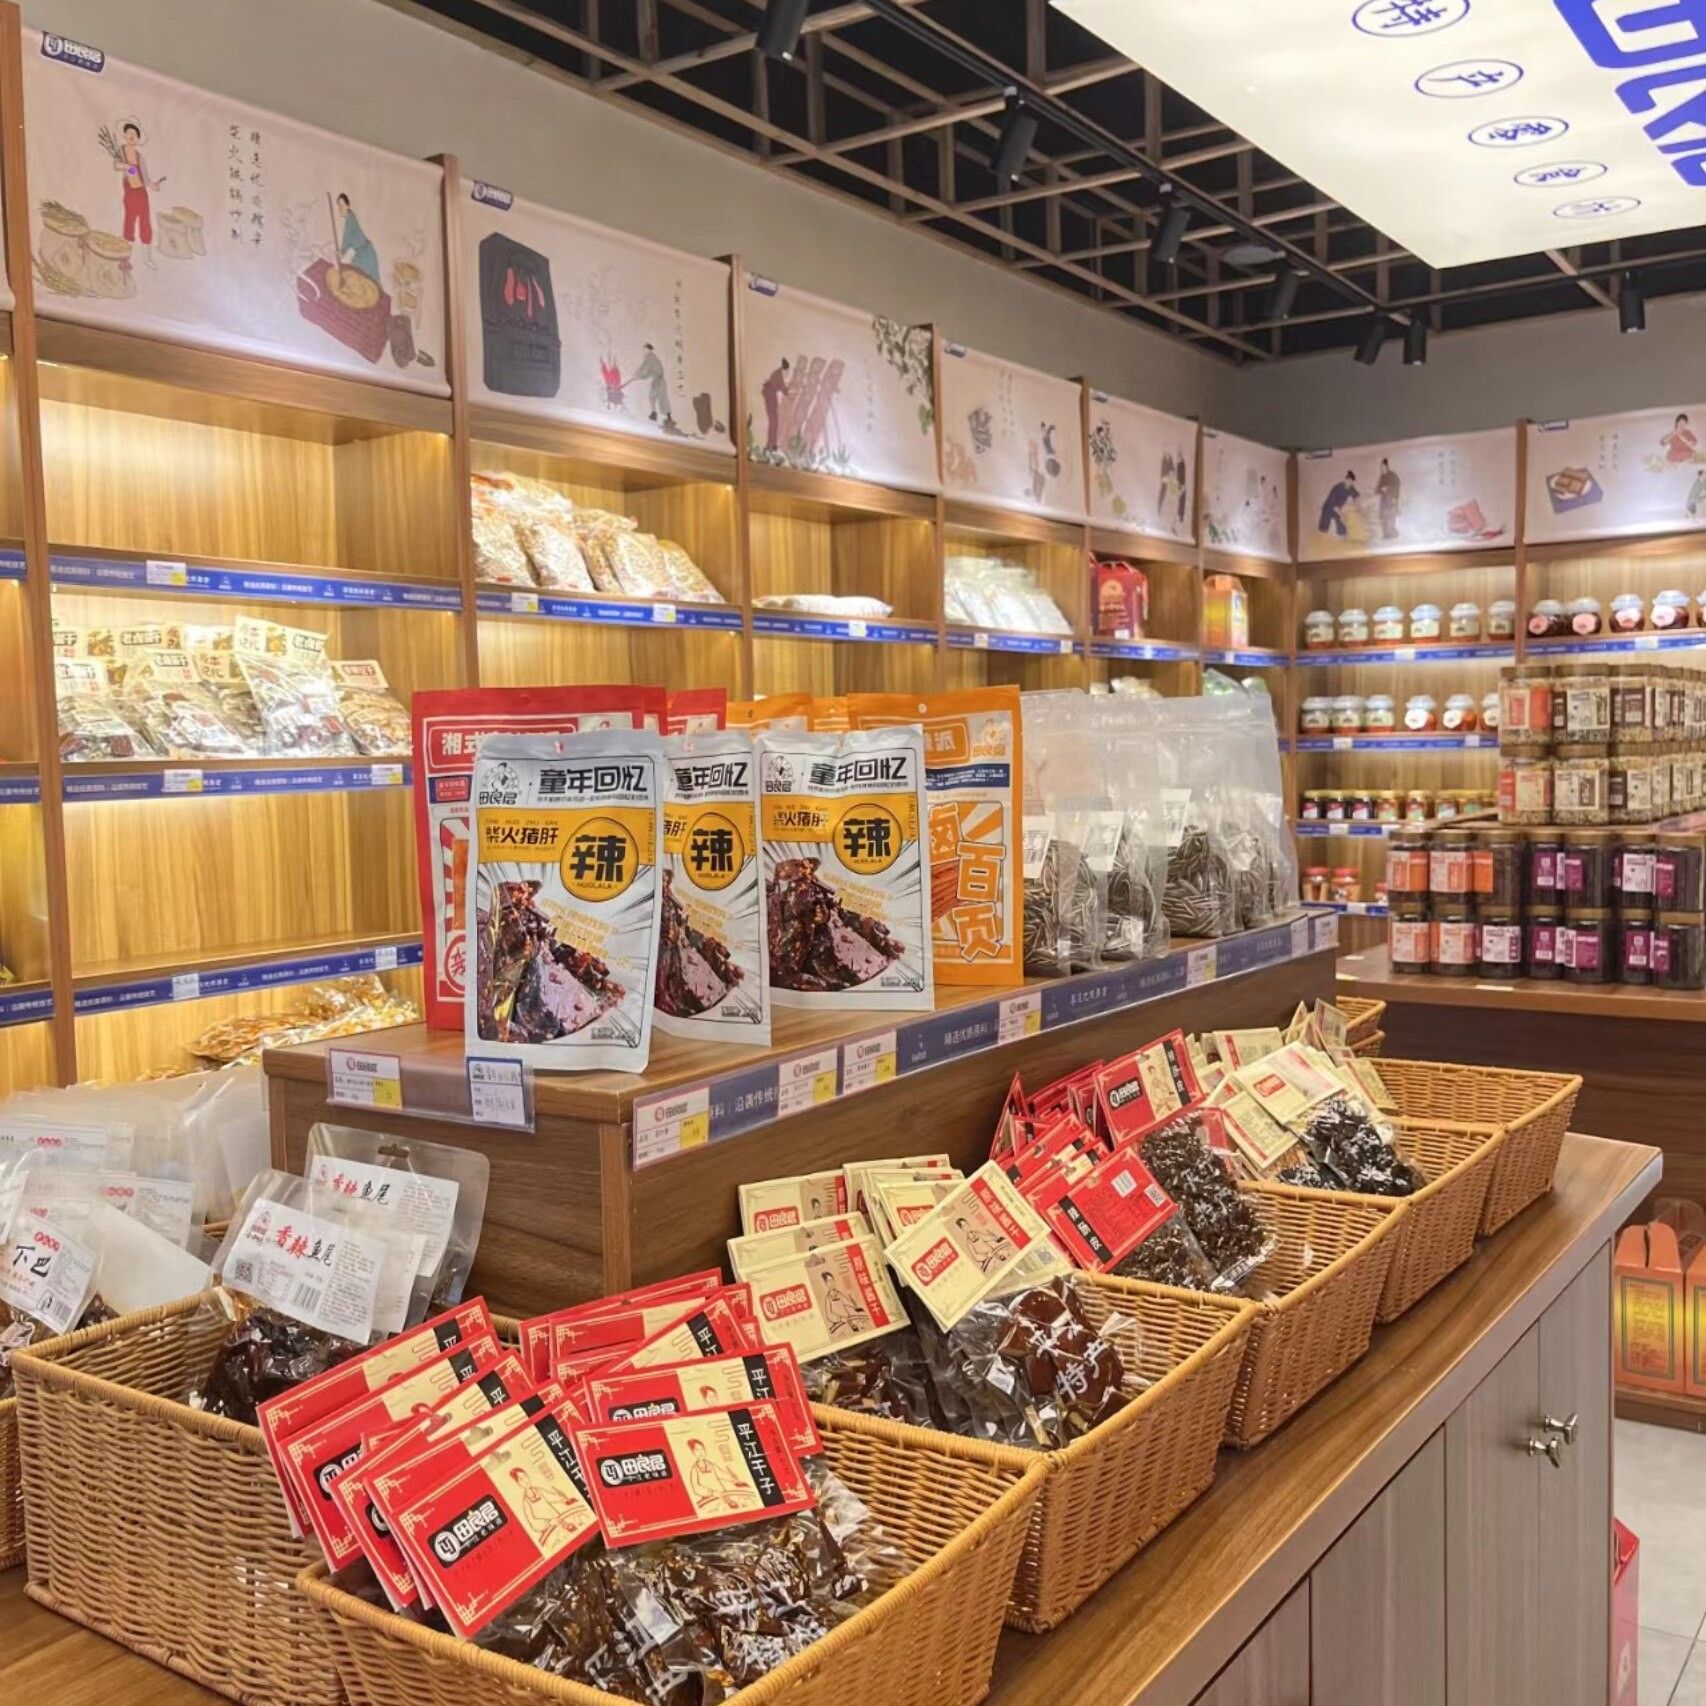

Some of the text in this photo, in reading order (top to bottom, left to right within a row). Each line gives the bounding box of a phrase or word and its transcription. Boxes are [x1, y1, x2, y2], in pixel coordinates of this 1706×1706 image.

[538, 765, 647, 794] 童年回忆
[675, 762, 749, 791] 童年回忆
[810, 757, 907, 786] 童年回忆
[486, 826, 559, 845] 柴火猪肝
[690, 828, 733, 872] 辣
[843, 818, 891, 858] 辣
[570, 829, 623, 883] 辣
[276, 1225, 336, 1267] 香辣鱼尾
[737, 1423, 775, 1495] 平江干子
